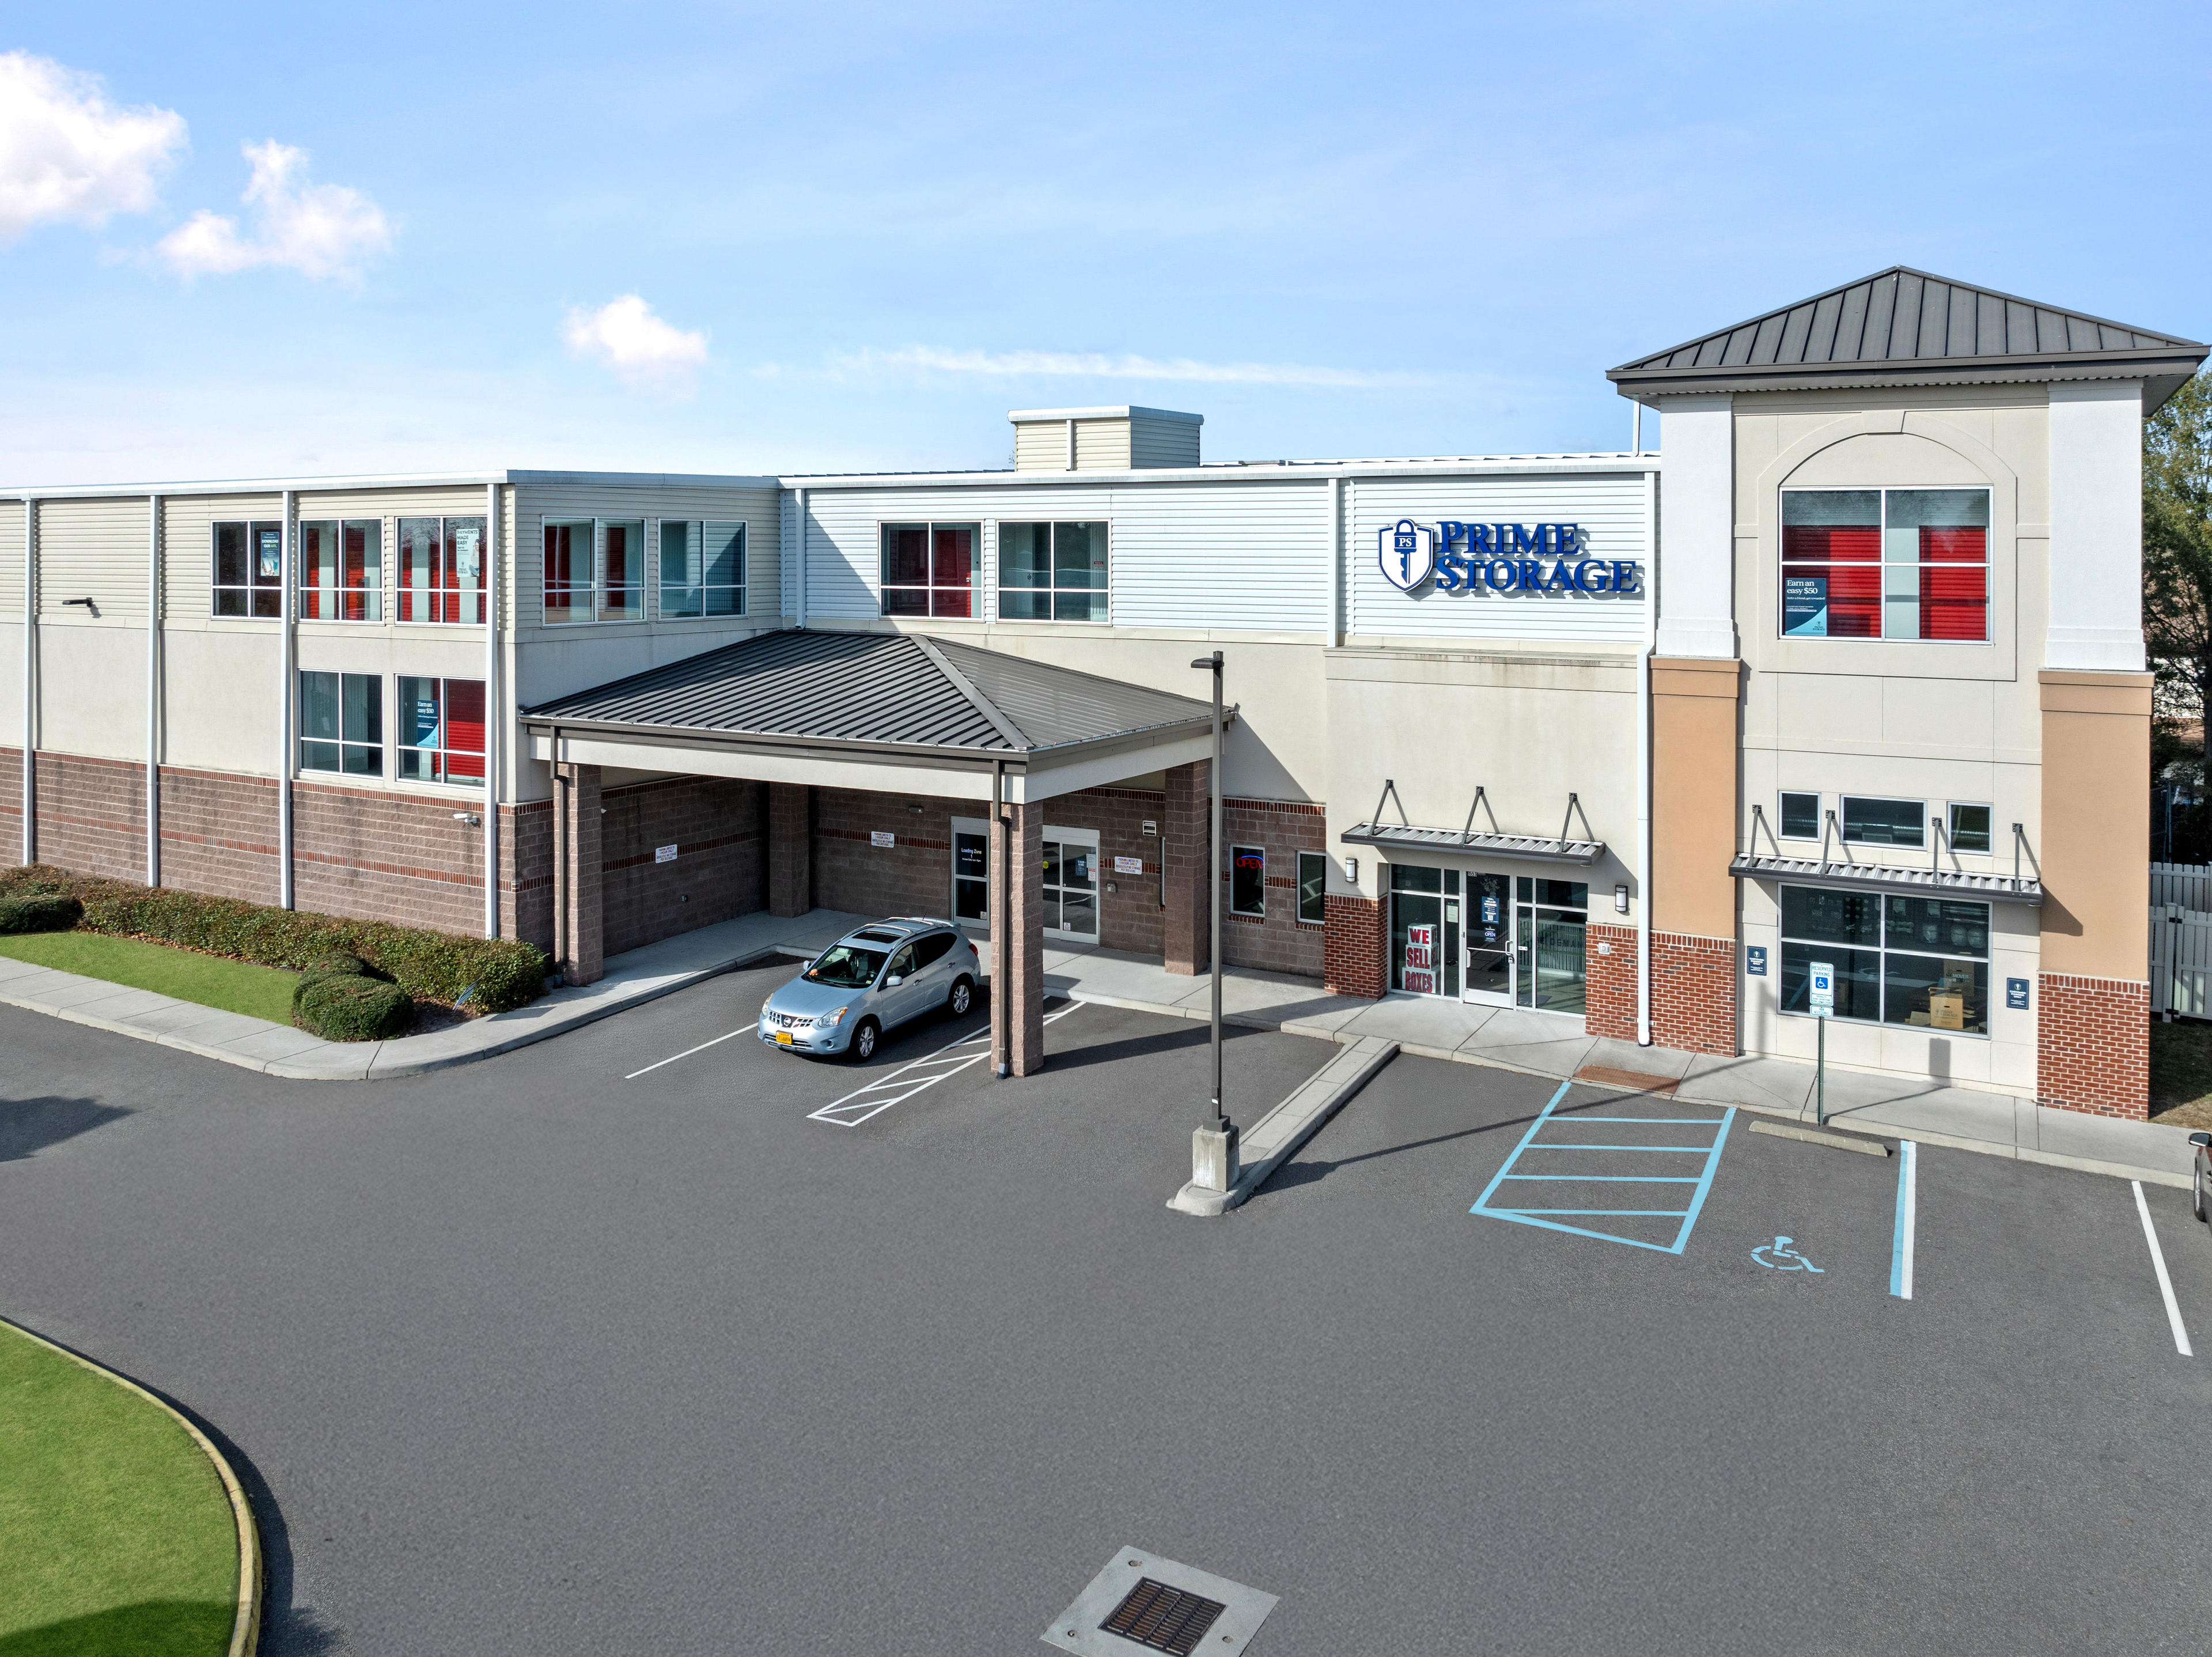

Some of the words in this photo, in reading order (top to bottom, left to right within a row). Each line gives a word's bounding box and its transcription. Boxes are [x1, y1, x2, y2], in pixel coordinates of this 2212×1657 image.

[1398, 537, 1412, 547] PS
[1436, 521, 1580, 555] PRIME
[1436, 555, 1638, 592] STORAGE
[1236, 857, 1263, 869] OPEN
[1409, 928, 1430, 944] WE
[1407, 947, 1430, 969] SELL
[1405, 971, 1433, 993] BOXES
